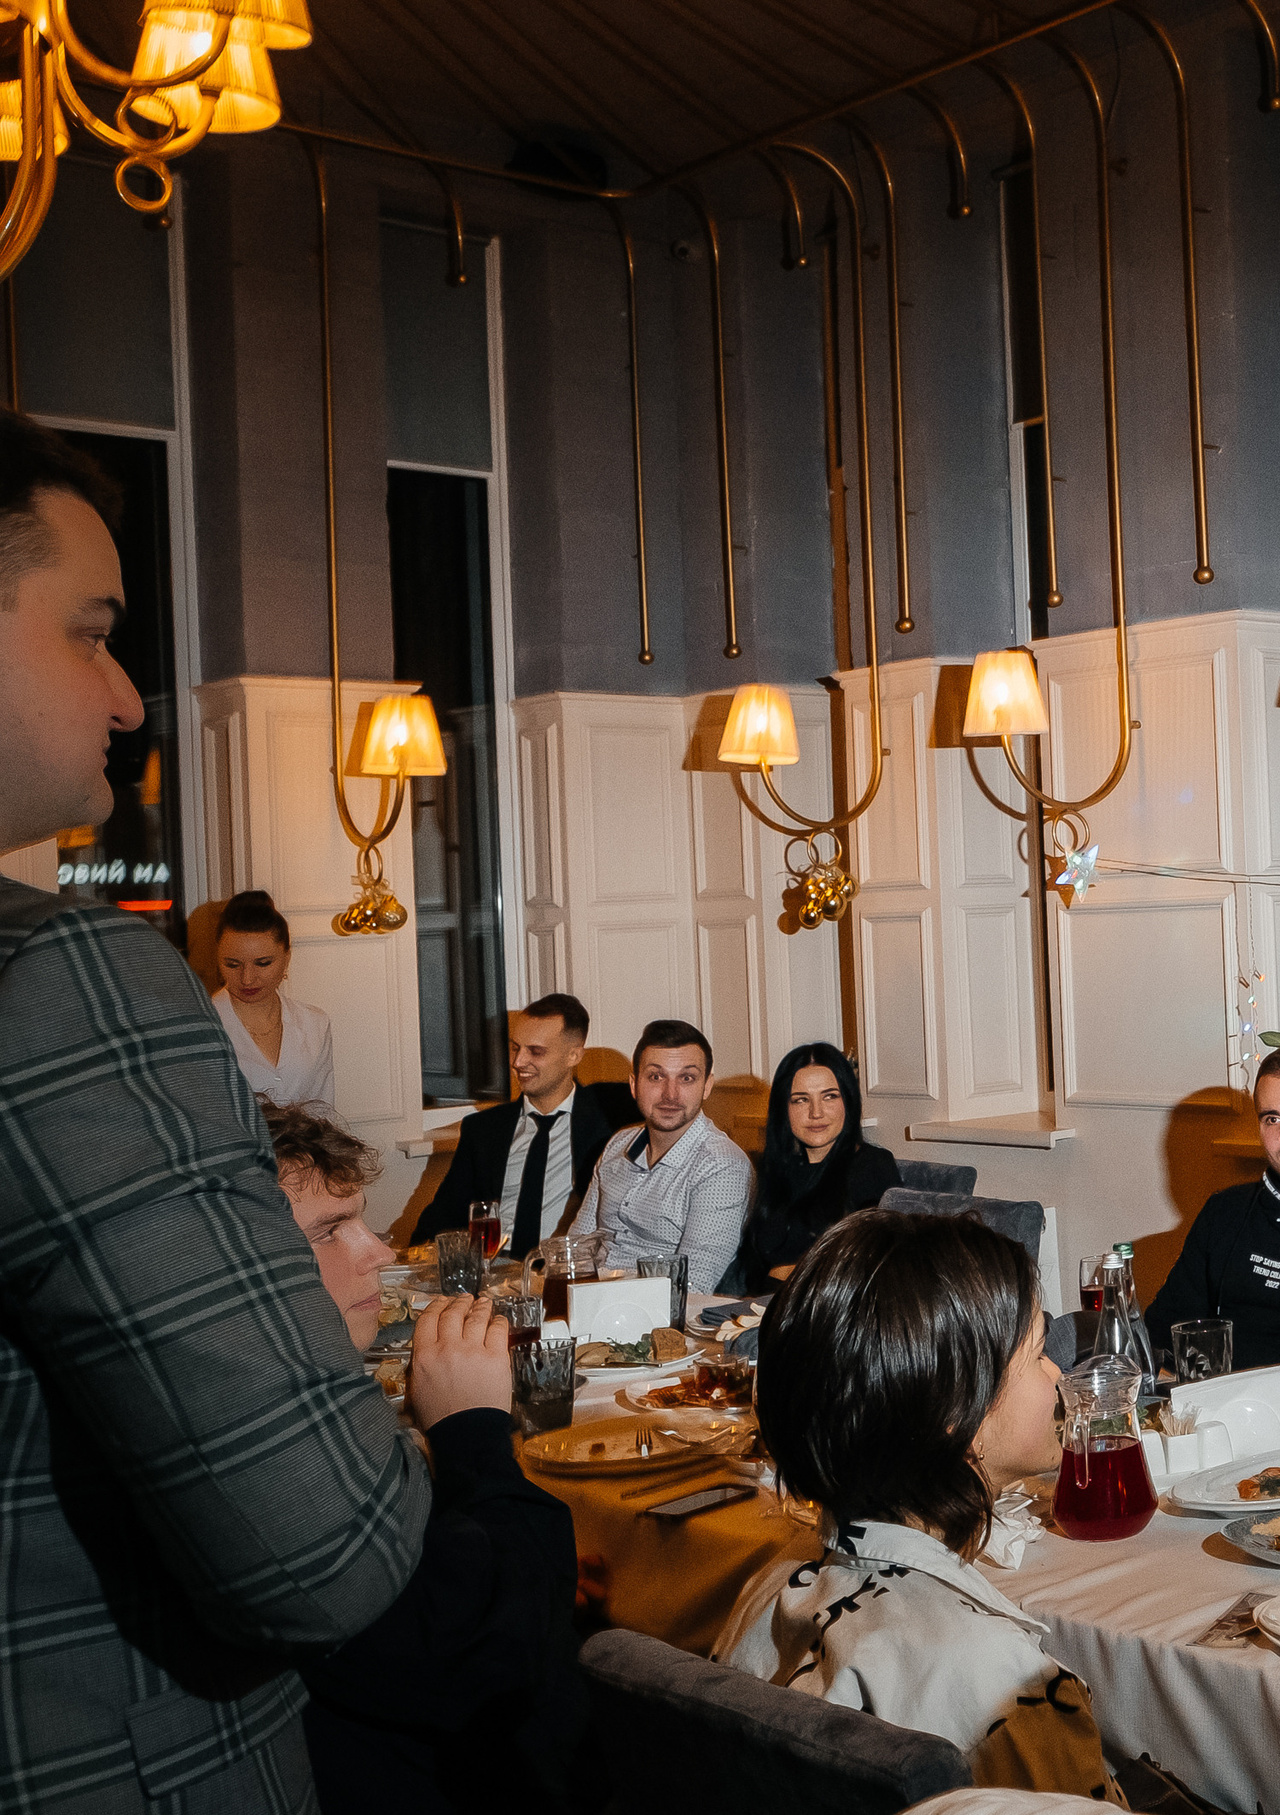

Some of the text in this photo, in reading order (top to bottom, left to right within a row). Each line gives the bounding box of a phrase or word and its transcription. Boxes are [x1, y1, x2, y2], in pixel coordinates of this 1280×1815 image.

[1250, 1253, 1264, 1264] STOP
[1253, 1265, 1271, 1277] TREND
[1265, 1279, 1280, 1289] 2022
